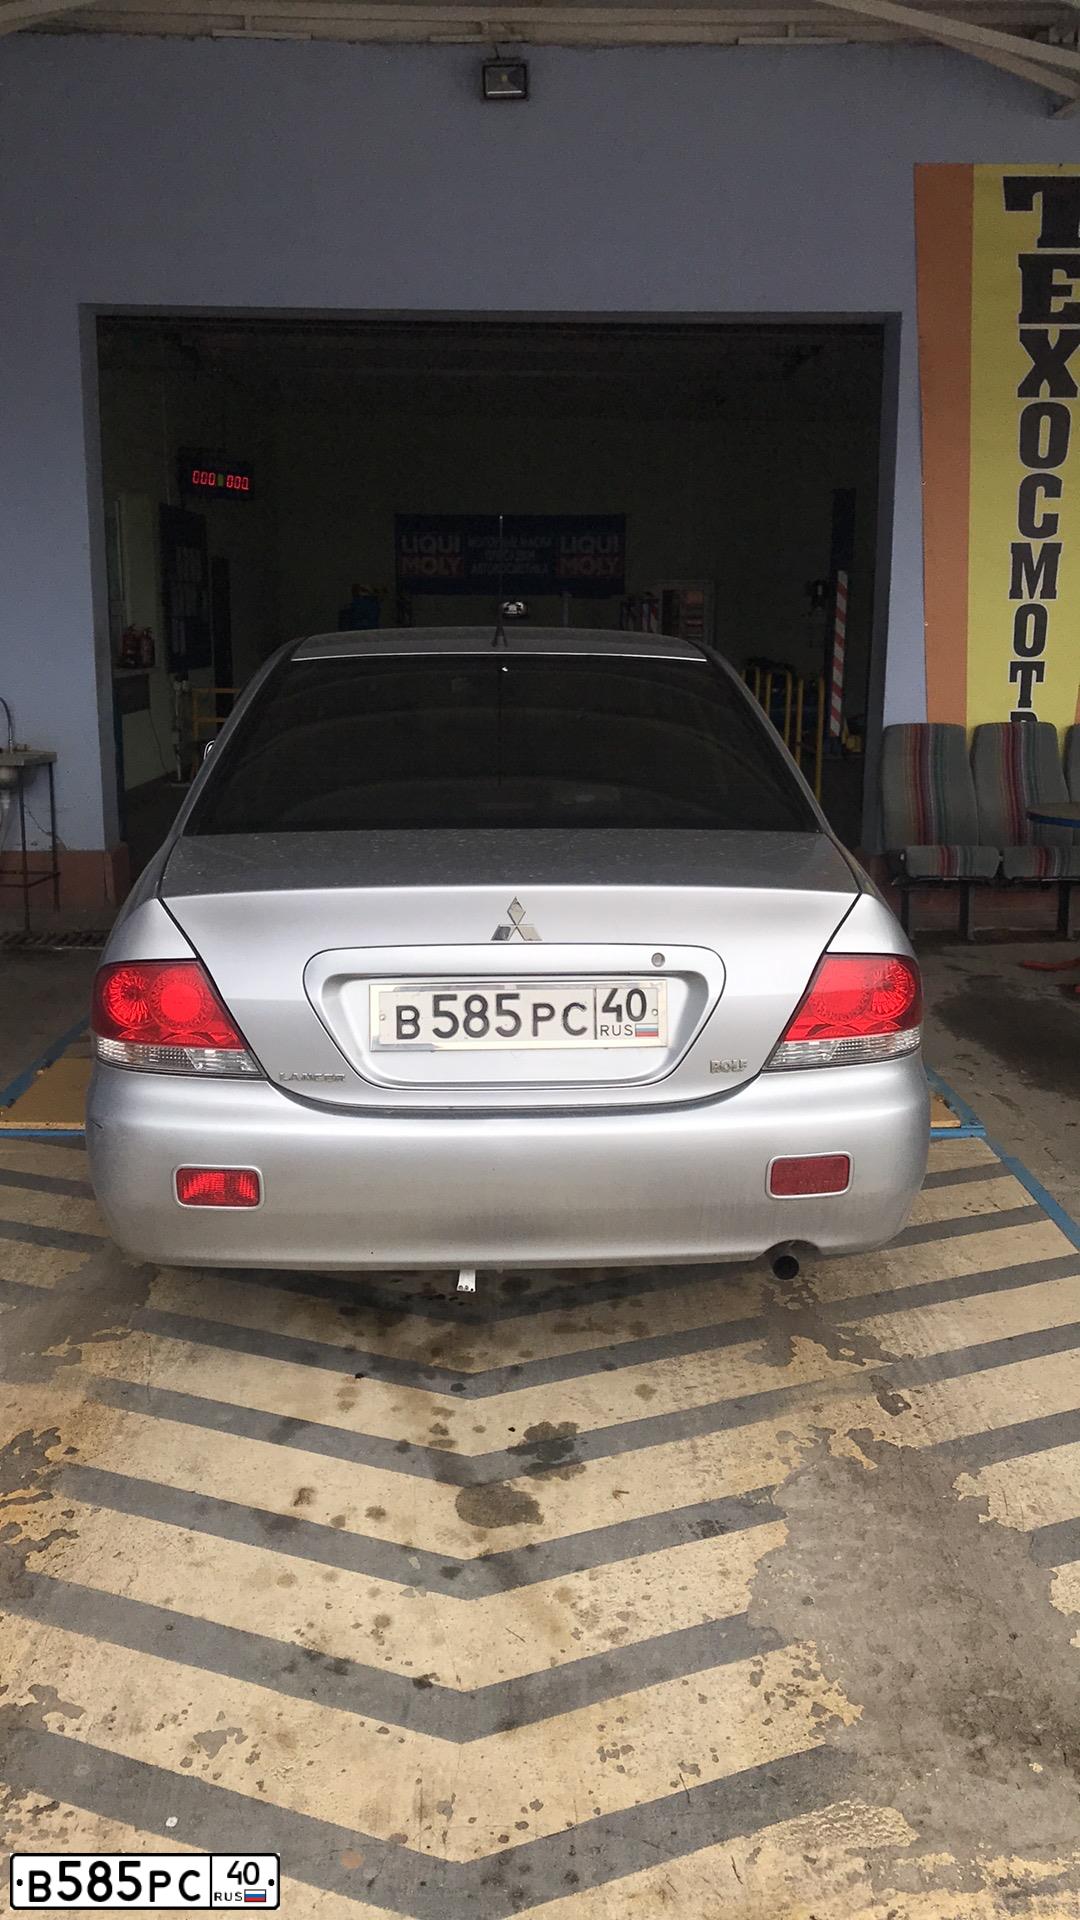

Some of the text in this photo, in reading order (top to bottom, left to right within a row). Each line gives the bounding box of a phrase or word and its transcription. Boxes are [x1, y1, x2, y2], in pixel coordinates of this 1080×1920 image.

[1003, 176, 1080, 722] ТЕХОСМОТ
[401, 535, 460, 554] LIQUI
[560, 535, 619, 554] LIQUI
[402, 556, 461, 574] MOLY
[560, 556, 619, 574] MOLY
[601, 988, 647, 1023] 40
[600, 1025, 633, 1036] RUS
